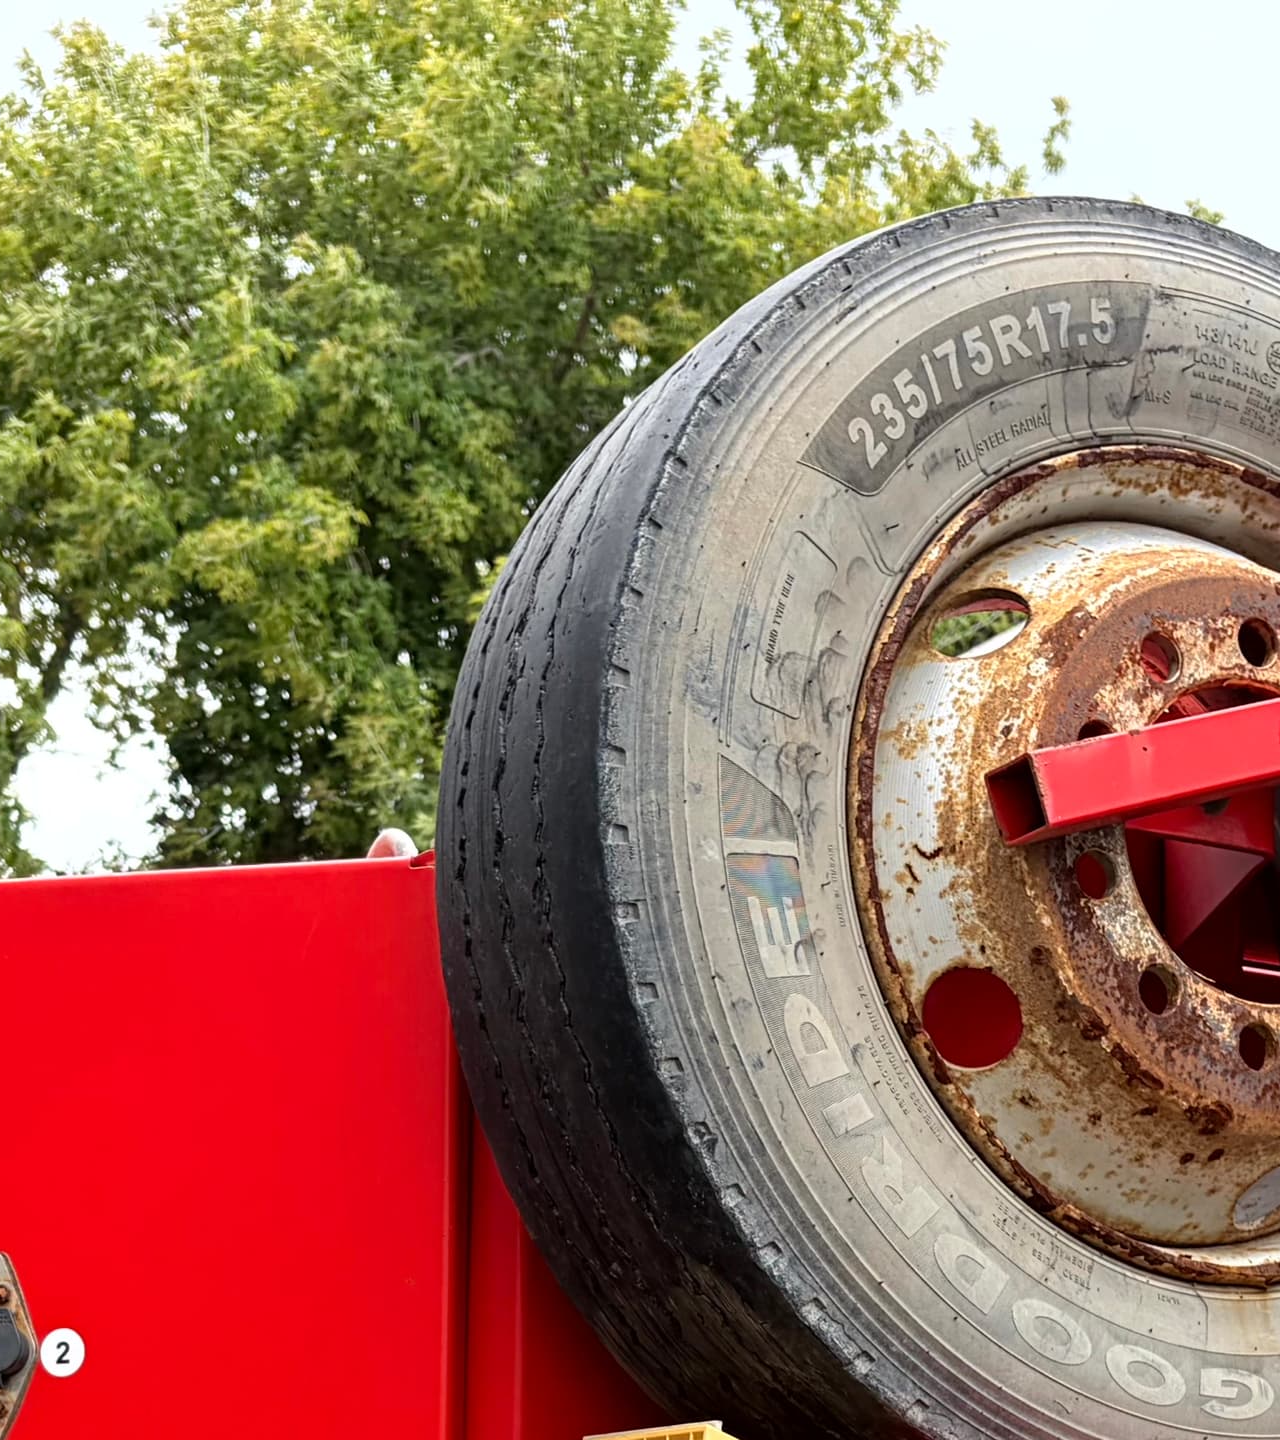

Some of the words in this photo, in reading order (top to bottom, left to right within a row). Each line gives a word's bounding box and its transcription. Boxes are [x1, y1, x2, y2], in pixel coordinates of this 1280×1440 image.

[847, 299, 1116, 470] 235/75R17.5
[1193, 350, 1226, 370] LOAD
[955, 448, 976, 471] ALL
[976, 430, 1009, 456] STEEL
[1010, 410, 1051, 438] RADIAL
[747, 896, 1275, 1420] GOODRIDE
[56, 1341, 70, 1364] 2
